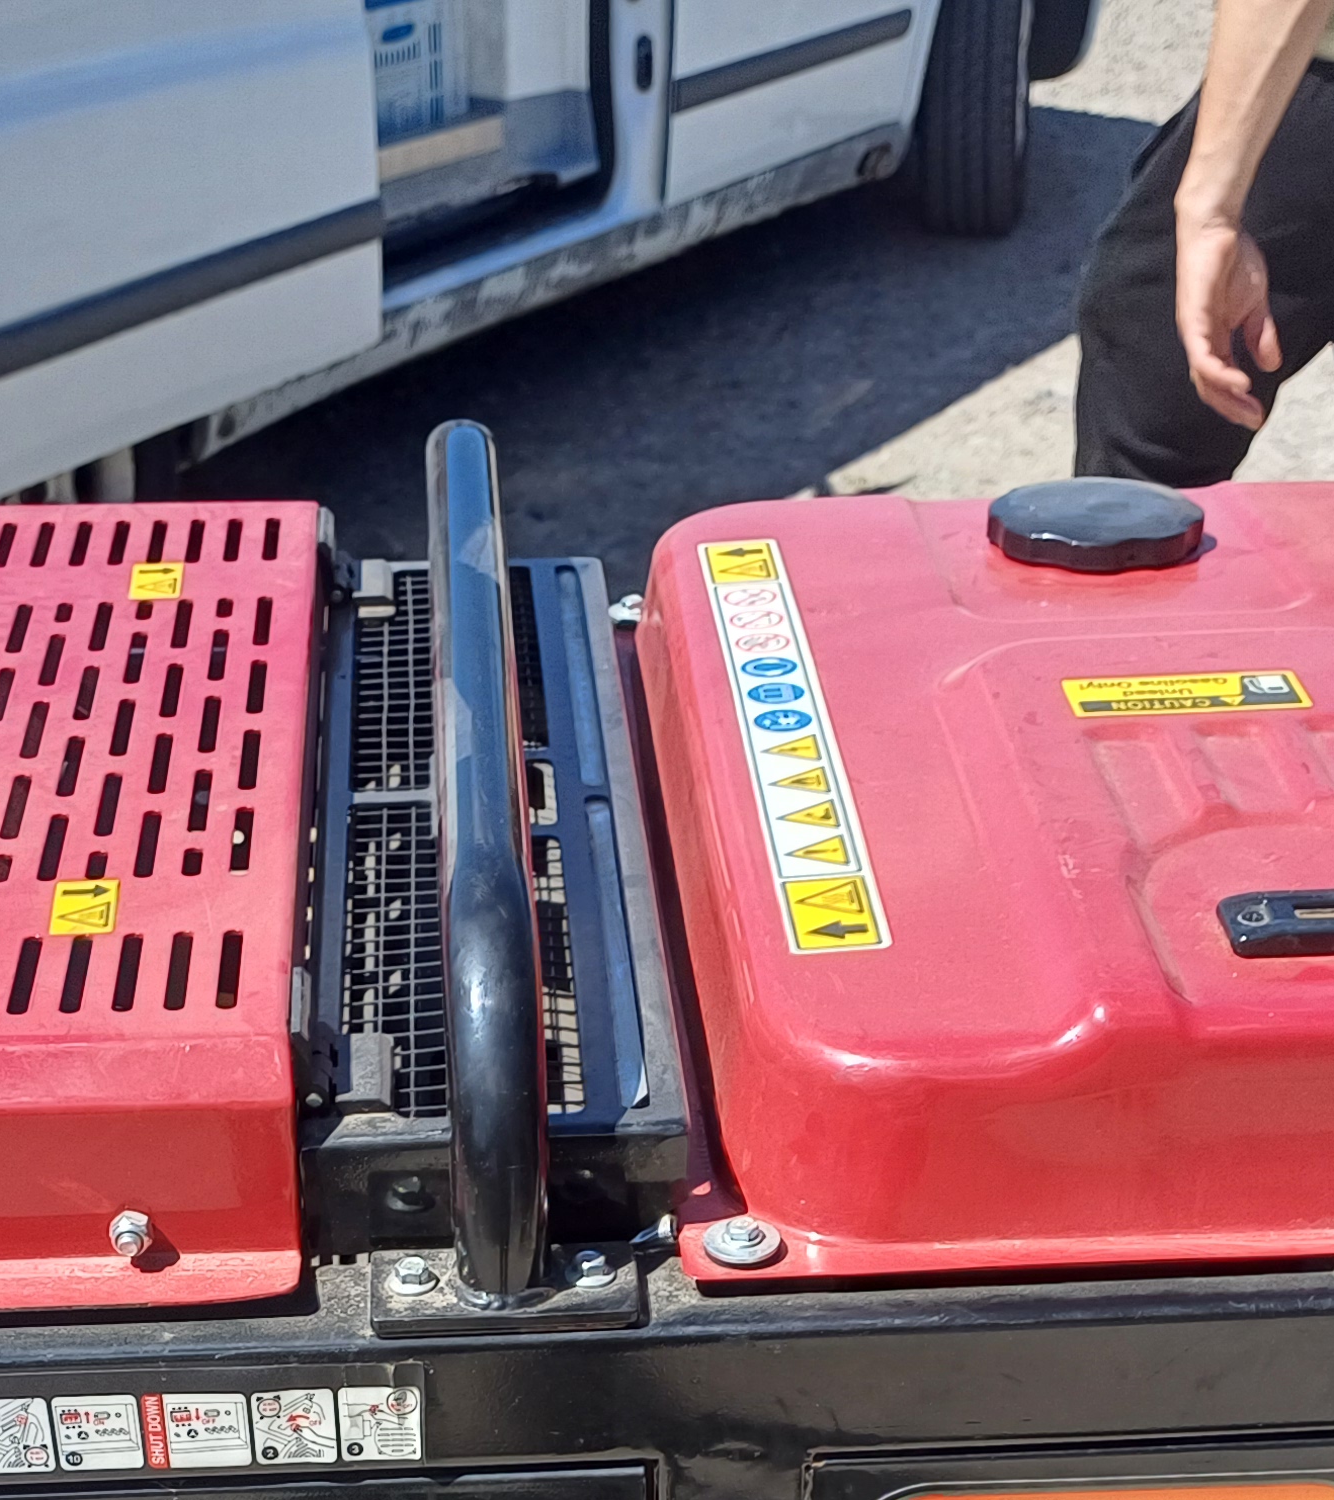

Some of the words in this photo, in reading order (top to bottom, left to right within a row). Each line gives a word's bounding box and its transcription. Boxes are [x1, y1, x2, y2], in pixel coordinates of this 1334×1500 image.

[1110, 698, 1212, 711] CAUTION
[144, 1396, 161, 1432] DOWN
[68, 1454, 81, 1464] 10
[149, 1434, 165, 1465] SHUT
